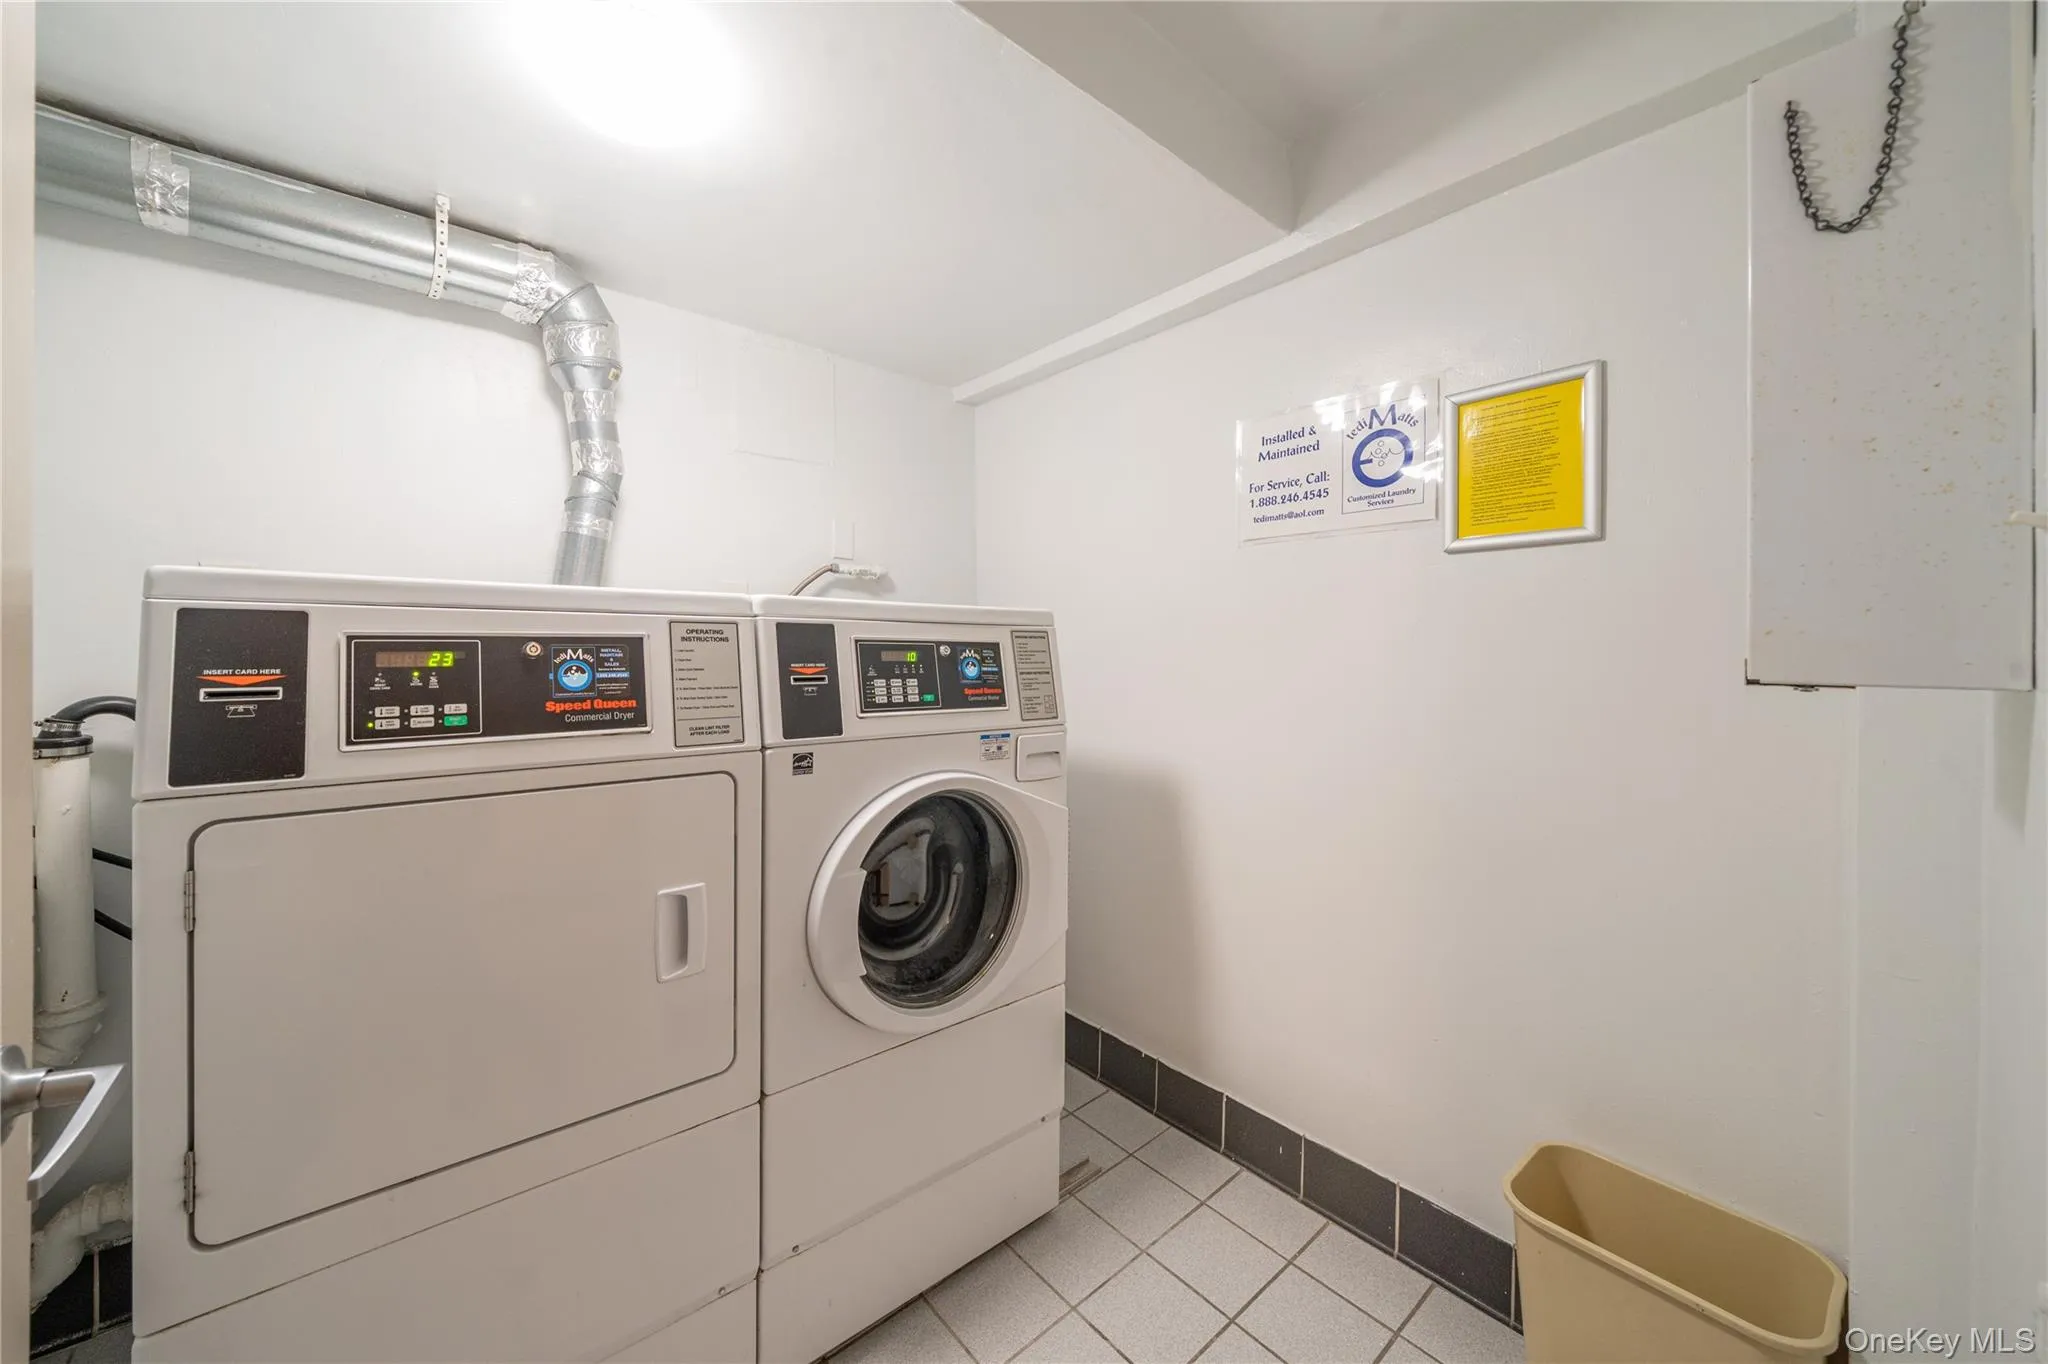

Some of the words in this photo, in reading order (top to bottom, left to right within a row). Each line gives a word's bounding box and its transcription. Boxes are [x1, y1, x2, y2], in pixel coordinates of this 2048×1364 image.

[1261, 427, 1305, 447] Installed
[1308, 425, 1317, 436] &
[1257, 440, 1320, 462] Maintained
[1249, 483, 1265, 494] For
[1267, 477, 1303, 491] Service,
[1306, 471, 1330, 485] Call:
[1250, 487, 1329, 508] 1.888.246.4545
[1347, 491, 1386, 503] Customized
[1387, 487, 1416, 497] Laundry
[1367, 498, 1394, 507] Services
[428, 652, 454, 667] 23
[907, 652, 917, 662] 10
[545, 699, 592, 713] Speed
[593, 698, 637, 710] Queen
[564, 711, 612, 723] Commercial
[613, 711, 635, 721] Dryer
